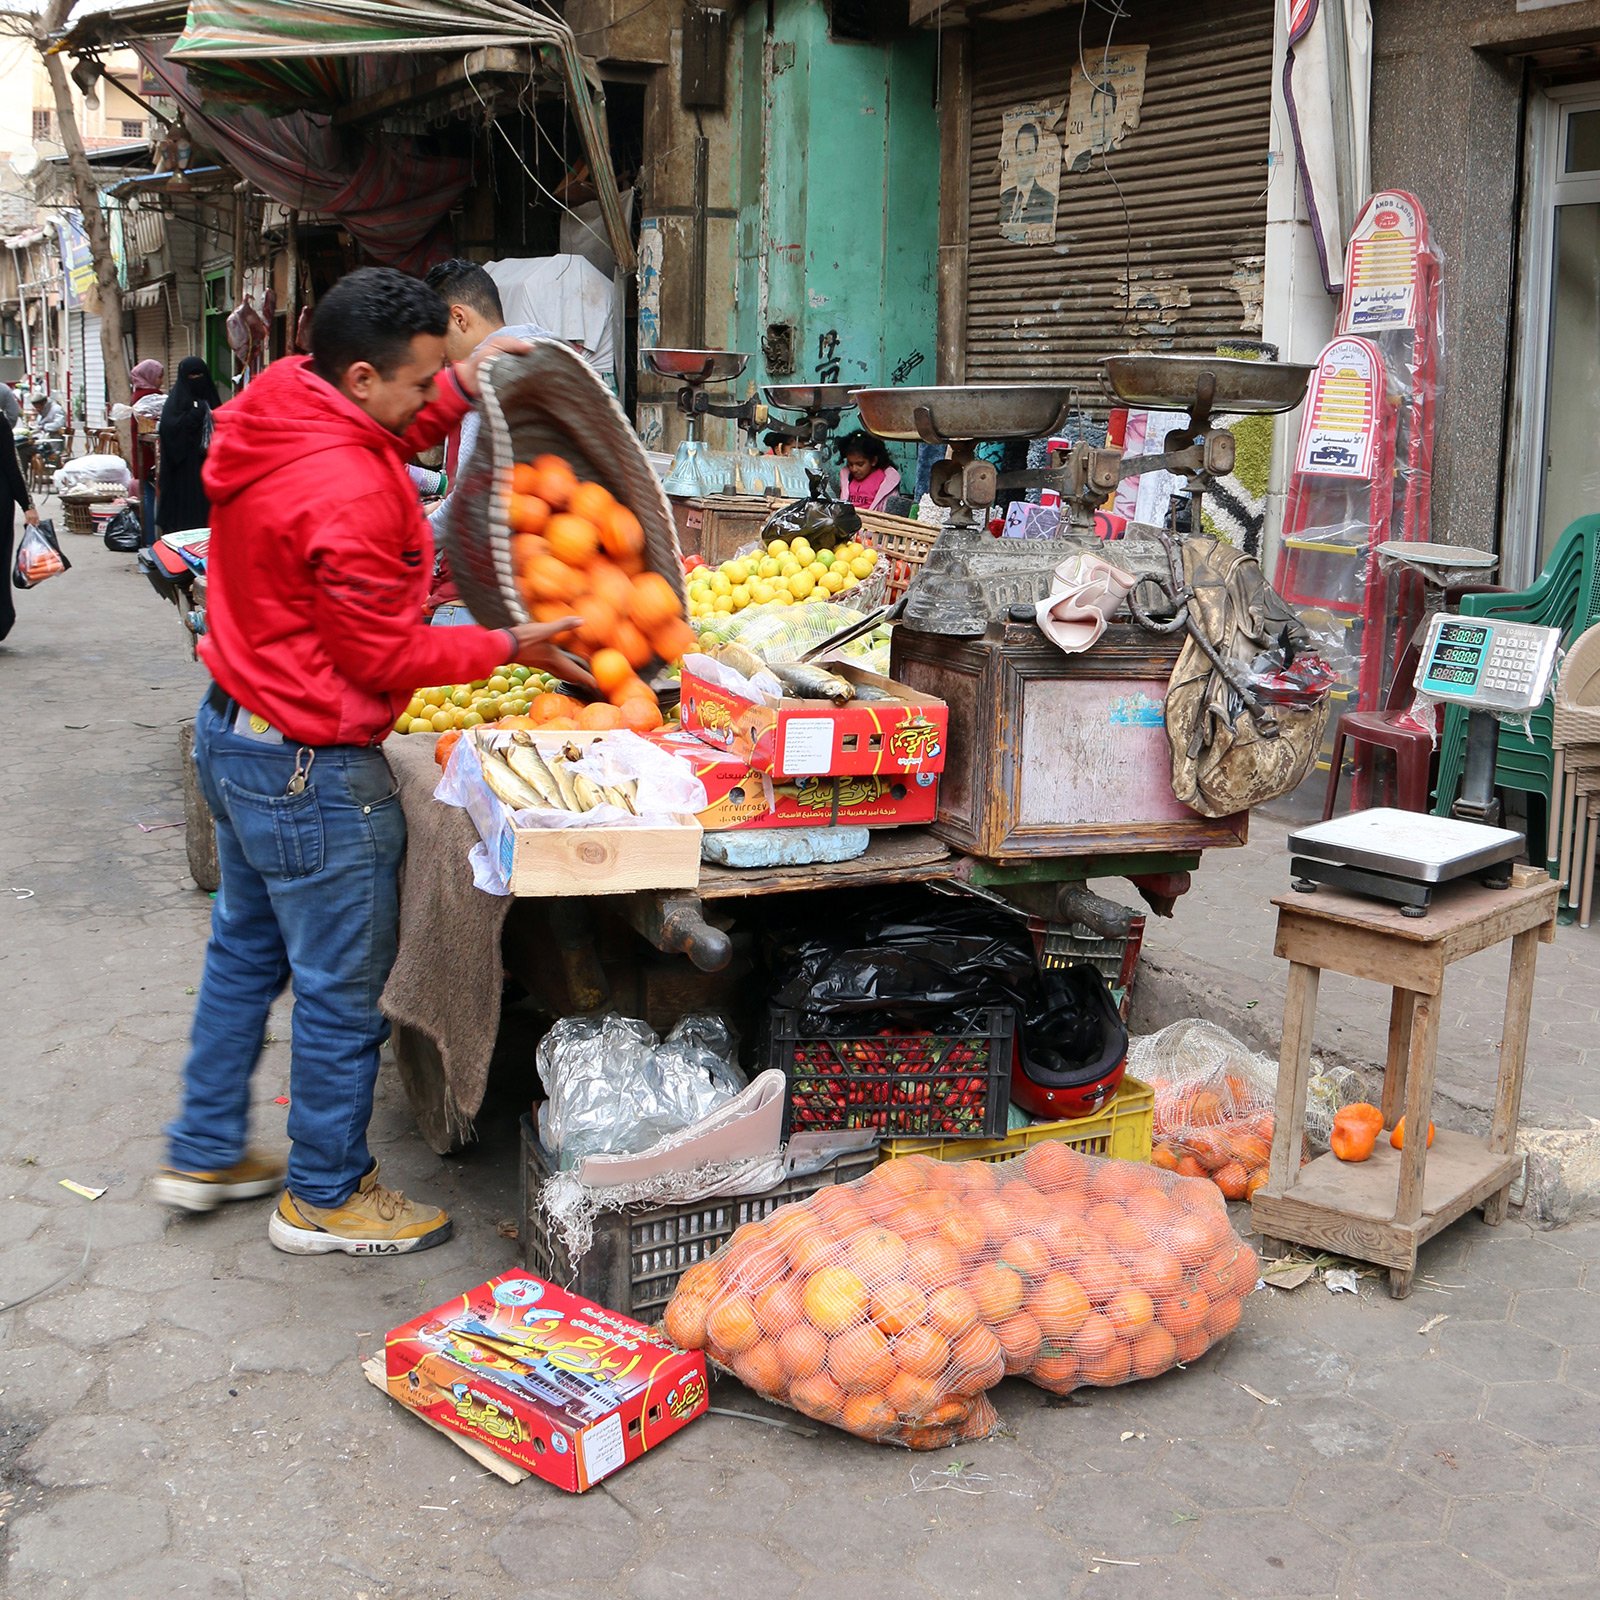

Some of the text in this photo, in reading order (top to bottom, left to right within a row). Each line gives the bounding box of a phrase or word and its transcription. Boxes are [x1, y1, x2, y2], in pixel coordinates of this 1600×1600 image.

[1070, 121, 1083, 134] 20
[1395, 202, 1415, 228] LADDER
[1353, 287, 1411, 307] المهندس
[1313, 453, 1356, 466] الرضا
[802, 811, 824, 819] وتصنيع
[880, 808, 897, 816] شركة
[355, 1244, 399, 1252] FILA
[548, 1350, 644, 1382] ابن
[685, 1375, 706, 1406] ابن
[455, 1392, 500, 1427] حميدو
[485, 1415, 523, 1445] ابن
[521, 1455, 537, 1467] شركة
